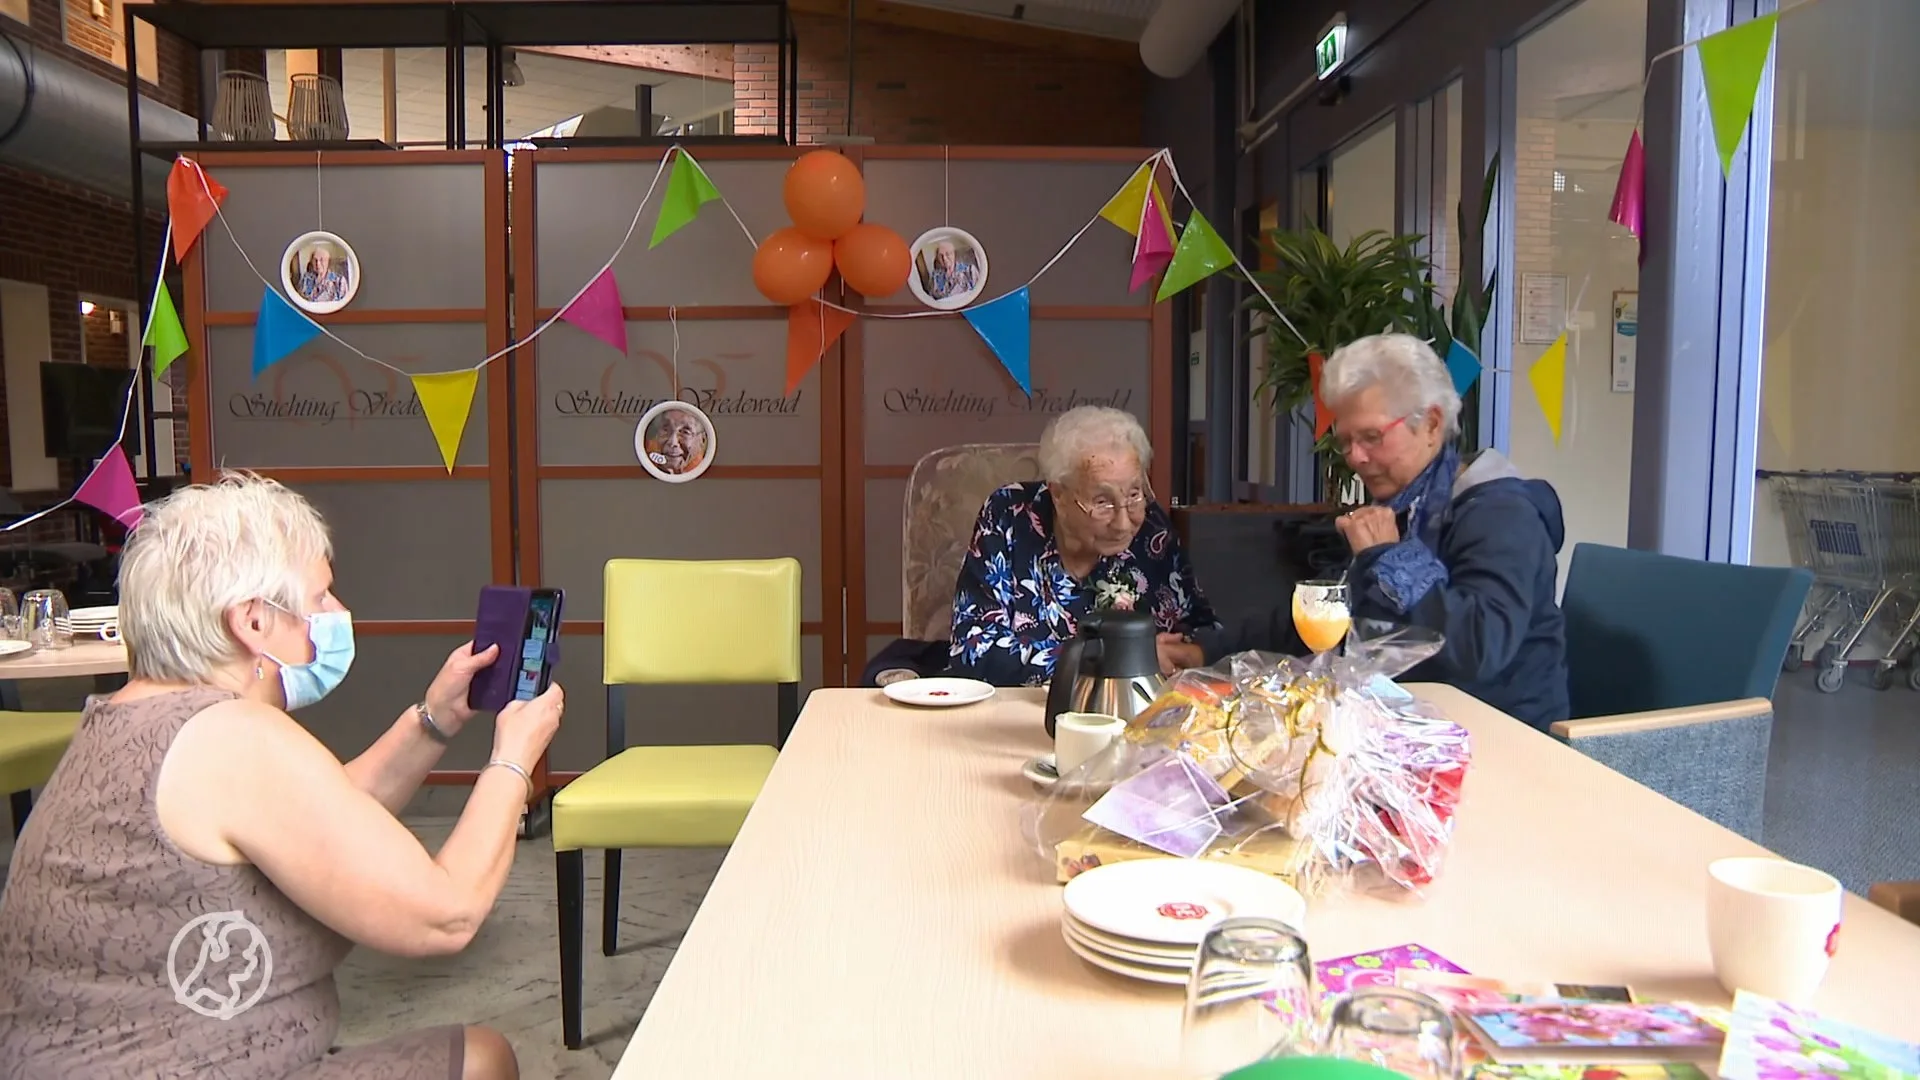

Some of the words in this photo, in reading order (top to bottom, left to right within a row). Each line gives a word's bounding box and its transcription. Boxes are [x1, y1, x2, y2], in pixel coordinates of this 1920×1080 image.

[229, 392, 339, 427] Stichting
[348, 389, 423, 416] Vrede
[554, 389, 656, 415] Stichtin
[678, 387, 802, 414] Vredewold
[883, 387, 1001, 422] Stichting
